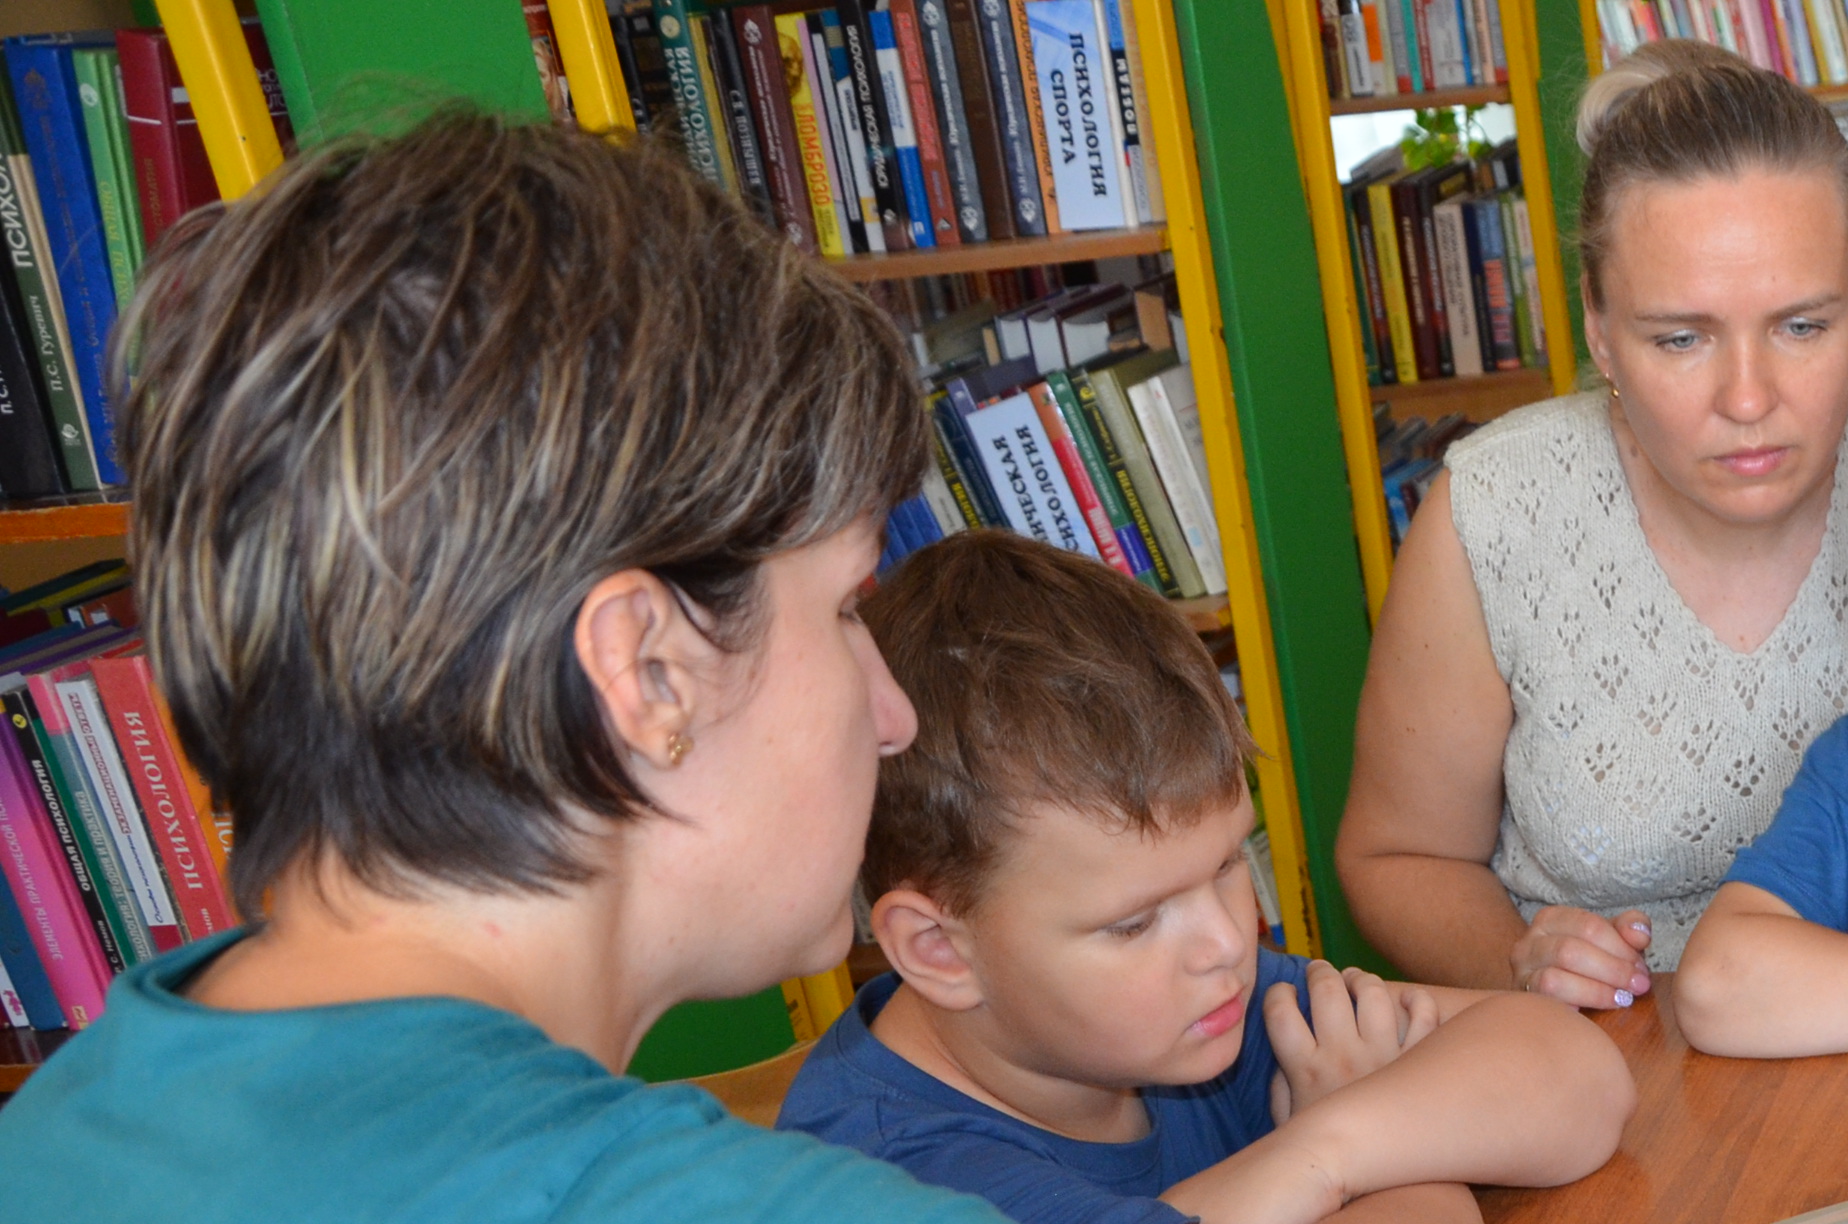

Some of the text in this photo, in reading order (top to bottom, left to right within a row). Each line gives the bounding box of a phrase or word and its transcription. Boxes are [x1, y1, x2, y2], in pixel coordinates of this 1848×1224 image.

[845, 23, 873, 103] ПСИХОЛОГИЯ
[1115, 57, 1137, 135] ПОБЕДЫ
[861, 103, 890, 189] ЮРИДИЧЕСКАЯ
[1050, 69, 1075, 163] СПОРТА
[1069, 33, 1107, 196] ПСИХОЛОГИЯ
[142, 156, 163, 227] СТОМАТИЯ
[796, 111, 830, 207] ЛОМБРОЗО
[31, 295, 56, 356] Гуревич
[993, 435, 1048, 541] ИЧЕСКАЯ
[1015, 425, 1079, 550] СИХОЛОГИЯ
[1114, 468, 1171, 583] ЭТНОПСИХОЛОГИЯ
[65, 689, 132, 836] ЭКЗАМЕНАЦИОННЫЕ ОТВЕТЫ
[121, 706, 205, 893] ПСИХОЛОГИЯ
[29, 756, 93, 893] ОБЩАЯ ПСИХОЛОГИЯ
[71, 788, 105, 846] практика
[0, 820, 43, 906] ПРАКТИЧЕСКОЙ
[96, 854, 125, 900] теория
[30, 904, 64, 963] ЭЛЕМЕНТЫ
[94, 918, 115, 953] Немов
[113, 897, 151, 964] сихология:
